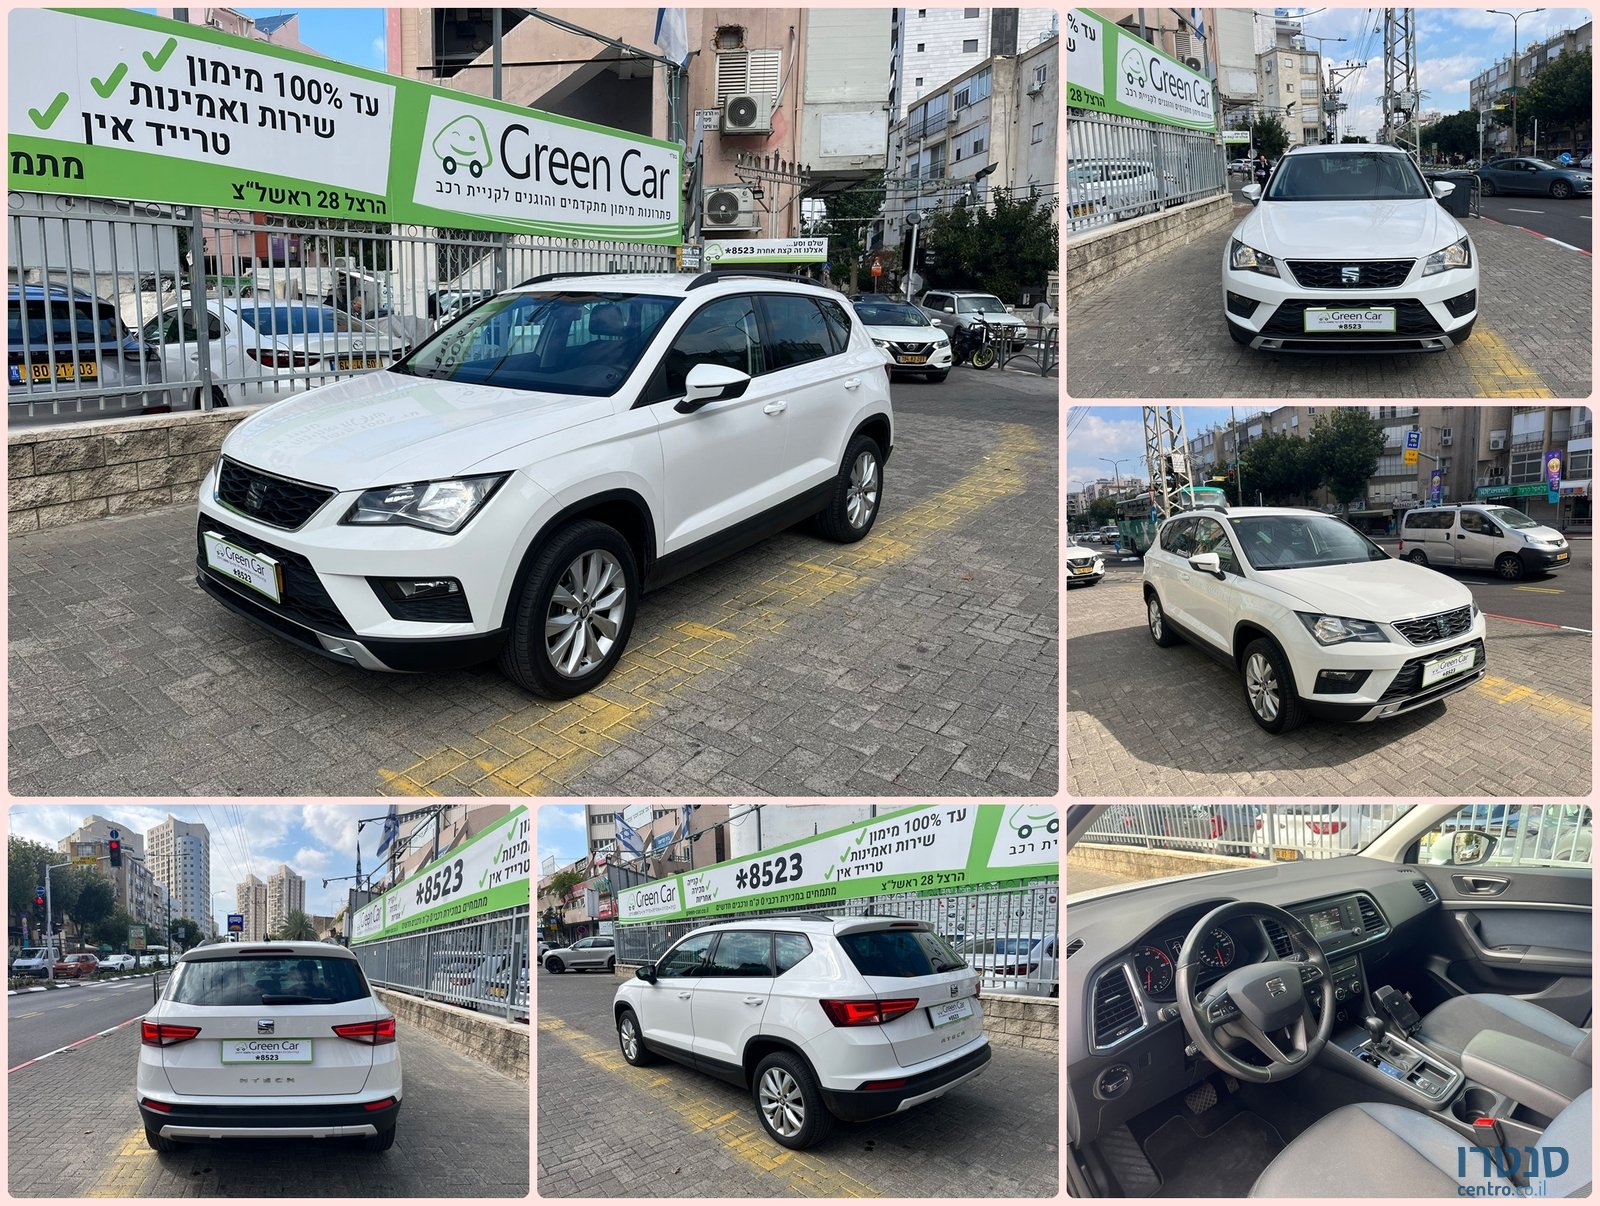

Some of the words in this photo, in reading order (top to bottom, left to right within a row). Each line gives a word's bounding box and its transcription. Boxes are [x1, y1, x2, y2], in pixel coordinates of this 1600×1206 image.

[1081, 22, 1096, 42] עד
[186, 55, 263, 93] מימון
[1150, 57, 1192, 101] Green
[1194, 80, 1210, 108] Car
[274, 72, 342, 110] 100%
[1070, 88, 1082, 102] 28
[1084, 90, 1106, 108] הרצל
[1126, 88, 1137, 98] רכב
[130, 81, 248, 123] ואמינות
[350, 92, 380, 117] עד
[81, 111, 136, 145] אין
[258, 106, 335, 138] שירות
[146, 120, 231, 156] טרייד
[500, 123, 611, 192] Green
[620, 149, 670, 201] Car
[436, 180, 460, 195] רכב
[466, 184, 510, 201] לקניית
[316, 191, 340, 210] 28
[346, 194, 387, 216] הרצל
[515, 191, 556, 206] והוגנים
[561, 197, 607, 214] מתקדמים
[610, 203, 636, 216] מימון
[638, 206, 672, 220] פתרונות
[1332, 312, 1362, 322] Green
[1364, 312, 1382, 321] Car
[225, 546, 251, 569] Green
[250, 560, 264, 576] Car
[1440, 657, 1458, 670] Green
[1458, 654, 1468, 664] Car
[904, 812, 942, 834] 100%
[947, 807, 967, 824] עד
[869, 822, 900, 846] מימון
[895, 834, 936, 854] שירות
[1009, 842, 1035, 856] רכב
[850, 844, 892, 862] ואמינות
[504, 859, 530, 880] טרייד
[836, 866, 850, 882] אין
[854, 860, 884, 878] טרייד
[936, 870, 966, 884] הרצל
[488, 870, 502, 890] אין
[920, 874, 934, 886] 28
[636, 890, 660, 908] Green
[660, 884, 676, 903] Car
[766, 896, 780, 905] רכבי
[780, 893, 804, 902] במכירת
[806, 886, 837, 899] מתמחים
[442, 906, 462, 918] במכירת
[462, 896, 488, 912] מתמחים
[942, 1001, 956, 1013] Green
[956, 998, 965, 1009] Car
[248, 1040, 280, 1051] Green
[282, 1041, 300, 1050] Car
